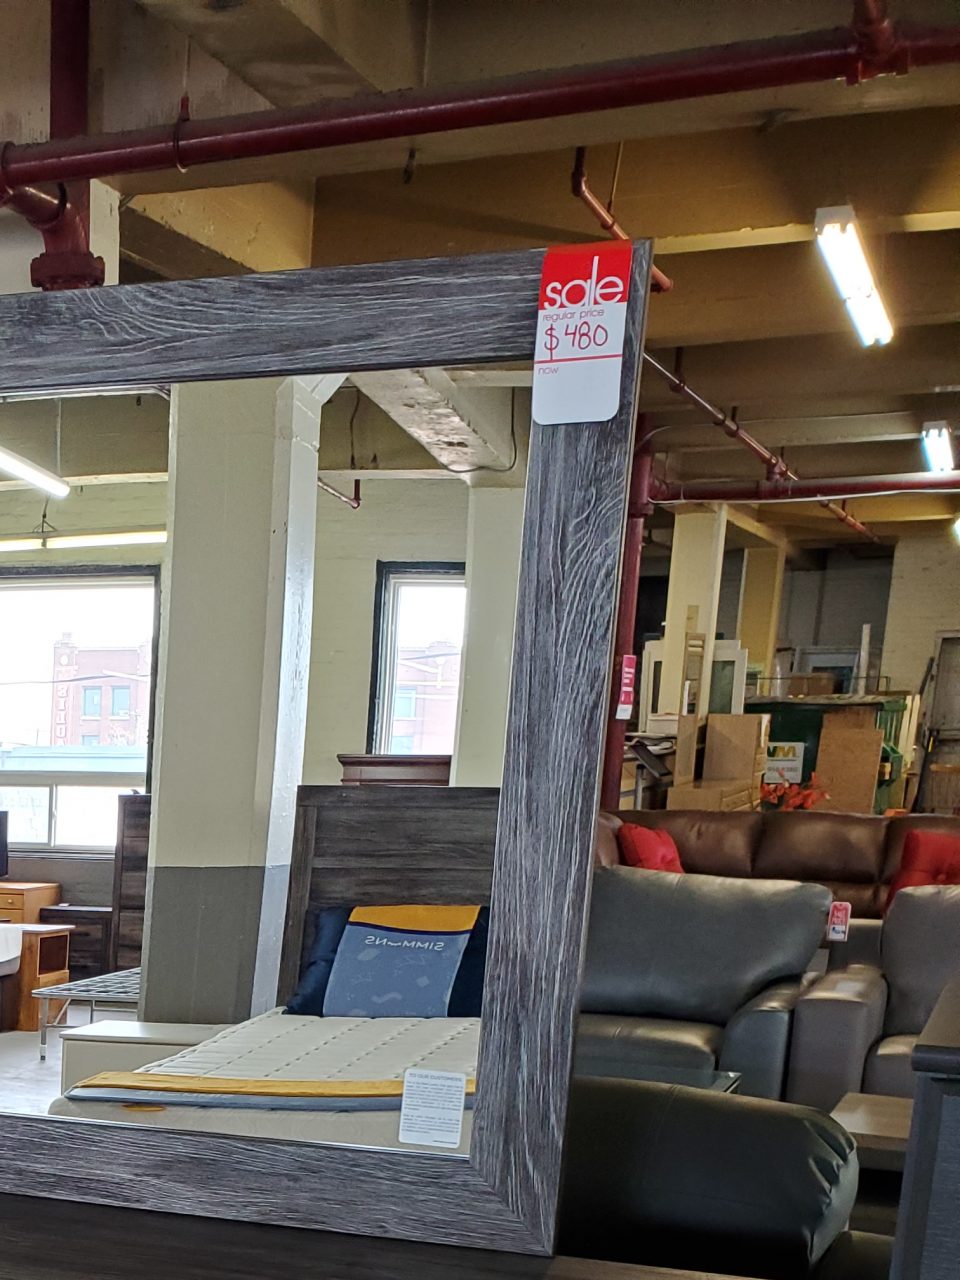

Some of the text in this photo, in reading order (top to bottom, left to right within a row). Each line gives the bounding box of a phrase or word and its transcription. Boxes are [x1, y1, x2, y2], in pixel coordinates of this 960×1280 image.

[543, 255, 624, 309] sale
[542, 308, 605, 322] regular price
[538, 366, 559, 375] now
